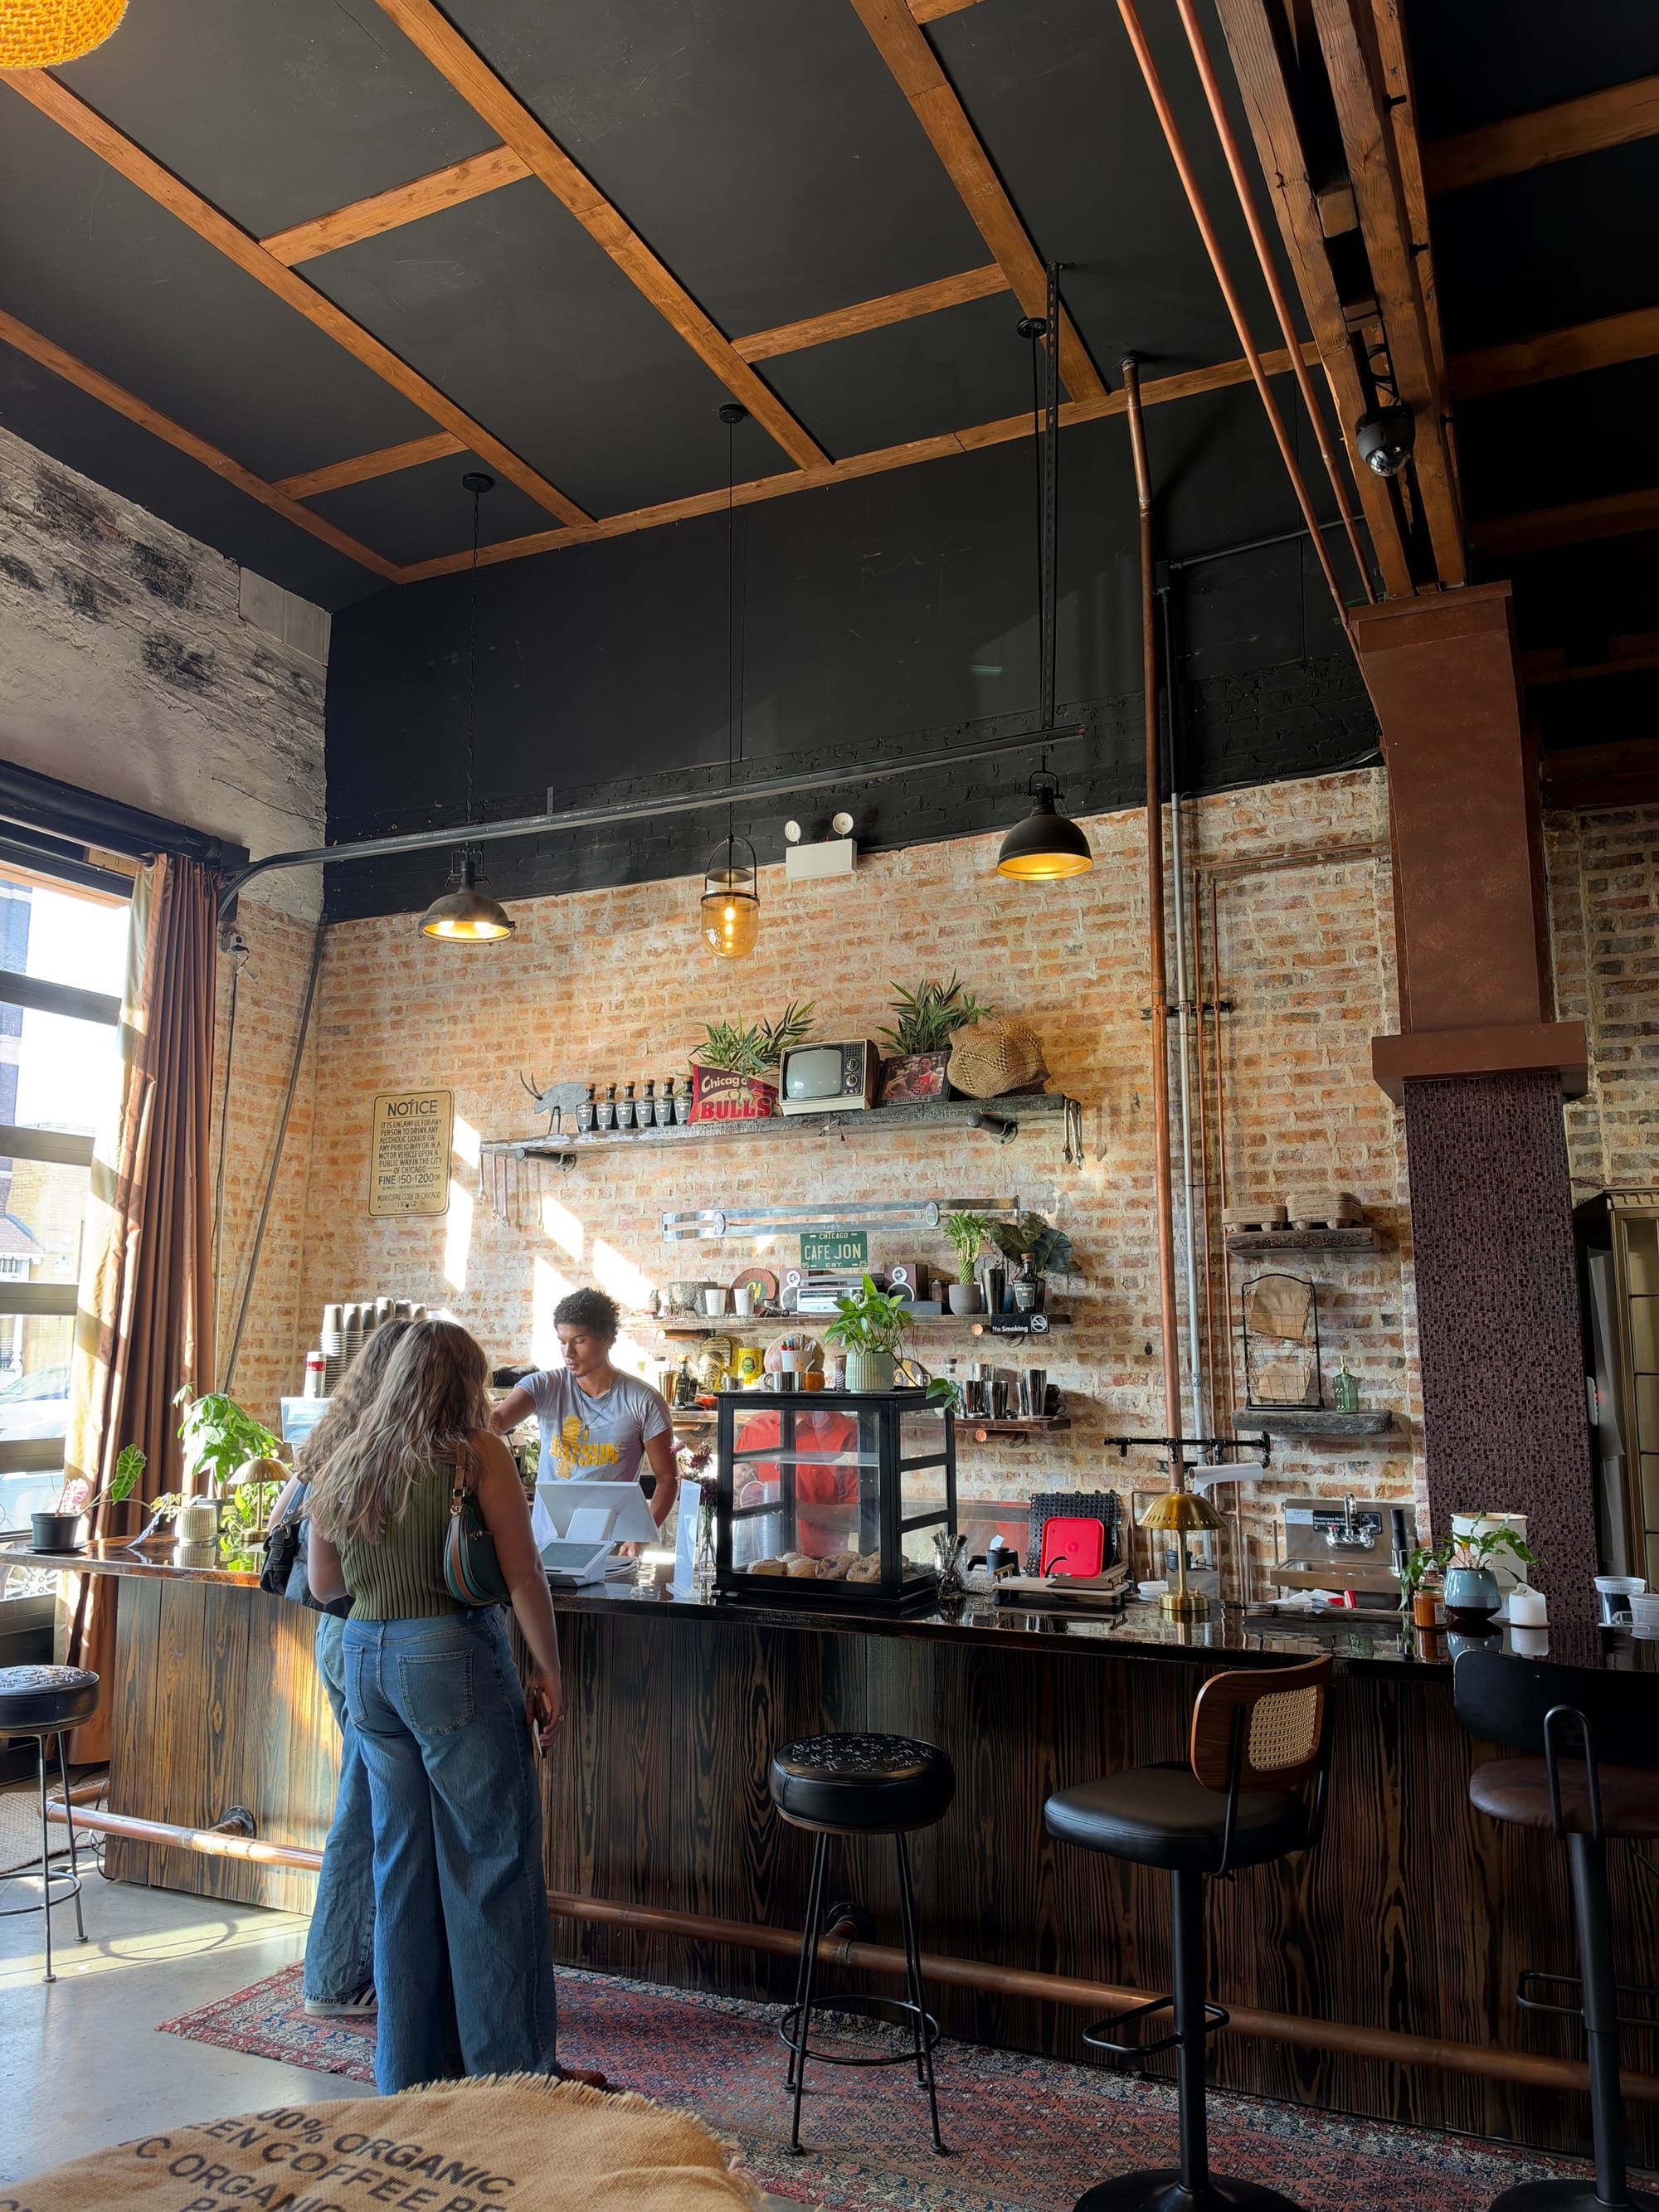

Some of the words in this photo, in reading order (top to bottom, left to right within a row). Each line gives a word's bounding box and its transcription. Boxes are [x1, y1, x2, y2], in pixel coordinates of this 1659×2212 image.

[701, 1075, 747, 1093] Chicago
[387, 1099, 438, 1116] NOTICE
[700, 1097, 771, 1120] BULLS
[393, 1120, 420, 1128] UNLAWFUL
[398, 1150, 417, 1159] VEHICLE
[431, 1156, 442, 1164] CITY
[401, 1165, 426, 1174] CHICAGO
[378, 1175, 396, 1184] FINE
[834, 1243, 862, 1260] JON
[255, 2107, 333, 2144] 00%
[333, 2132, 516, 2195] ORGANIC
[261, 2142, 440, 2211] COFFEE
